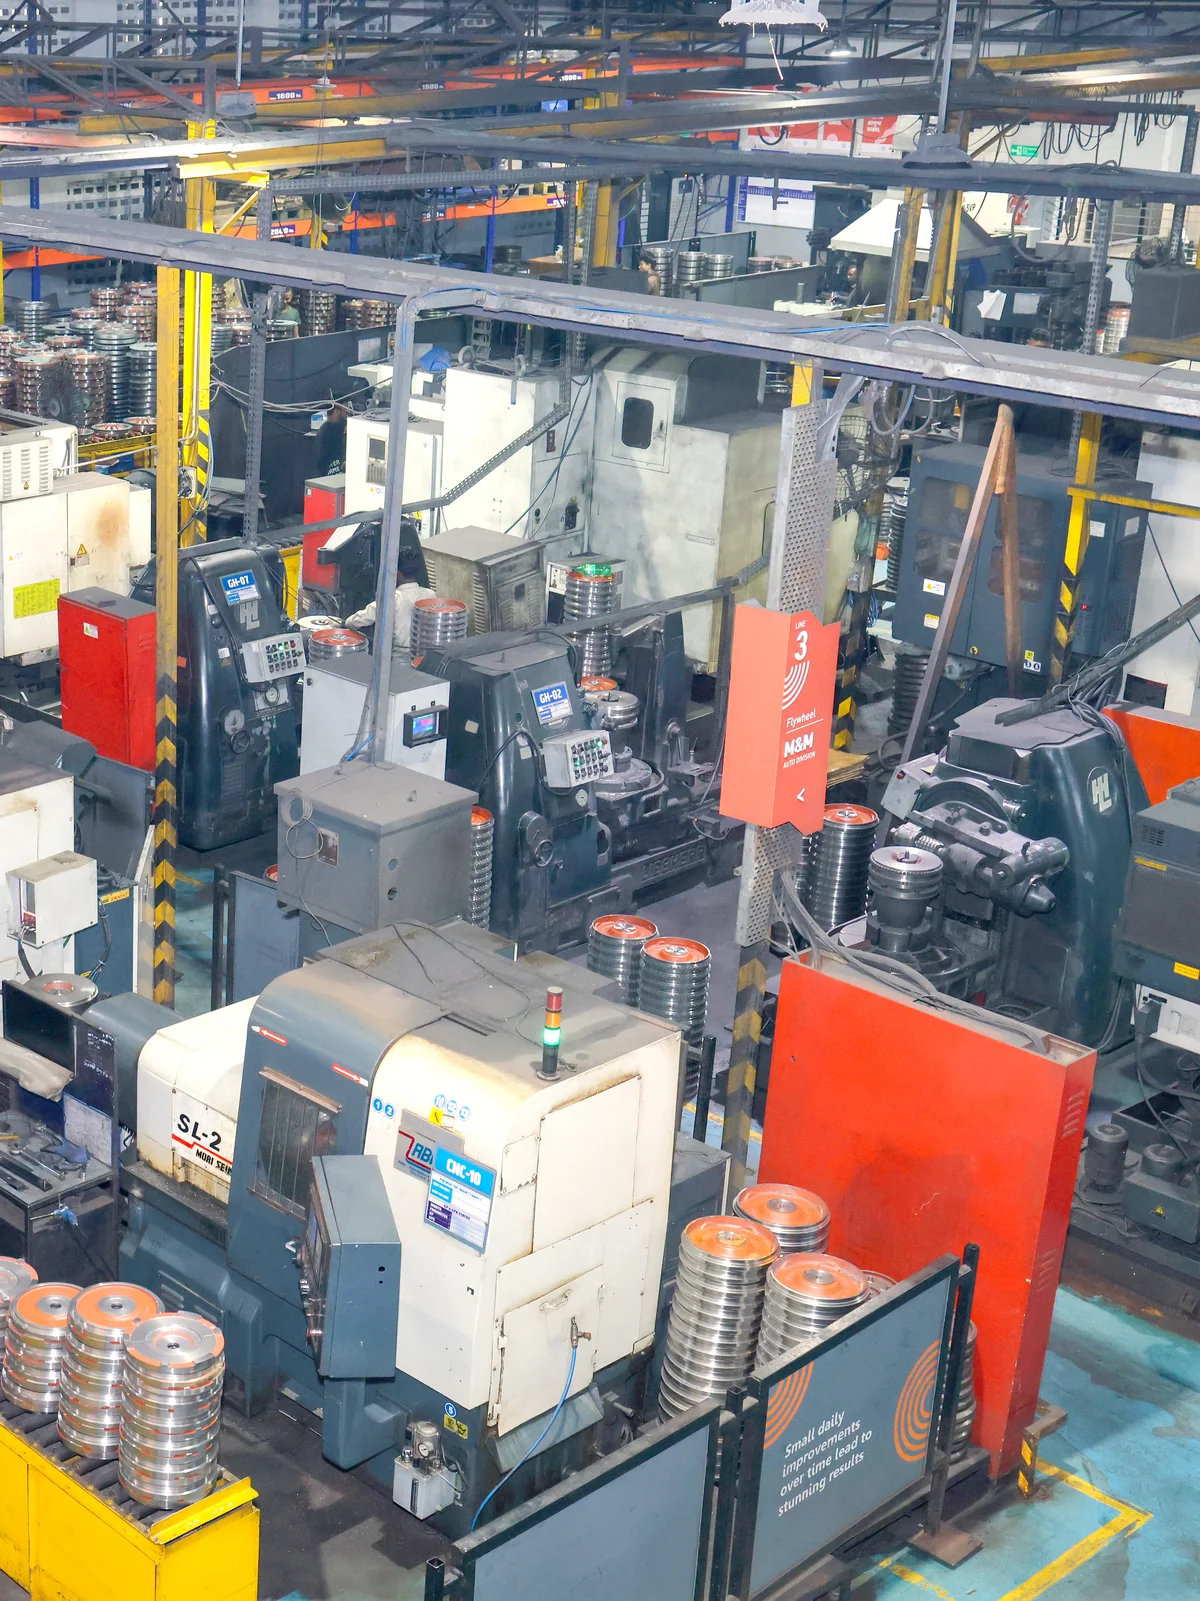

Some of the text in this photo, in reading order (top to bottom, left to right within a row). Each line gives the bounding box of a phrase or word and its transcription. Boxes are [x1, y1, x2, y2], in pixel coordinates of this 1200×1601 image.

[227, 575, 250, 588] GH-07
[795, 619, 807, 630] LINE
[794, 629, 809, 661] 3
[539, 688, 563, 704] GH-02
[786, 707, 817, 728] Flywheel
[783, 731, 814, 758] M&M
[782, 750, 817, 769] AUTO DIVISION
[177, 1113, 222, 1152] SL-2
[195, 1149, 214, 1165] MORI
[446, 1157, 482, 1187] CNC-10
[782, 1419, 861, 1478] improvements
[784, 1411, 845, 1459] Small daily
[780, 1430, 873, 1497] over time lead to
[778, 1451, 865, 1517] stunning results
